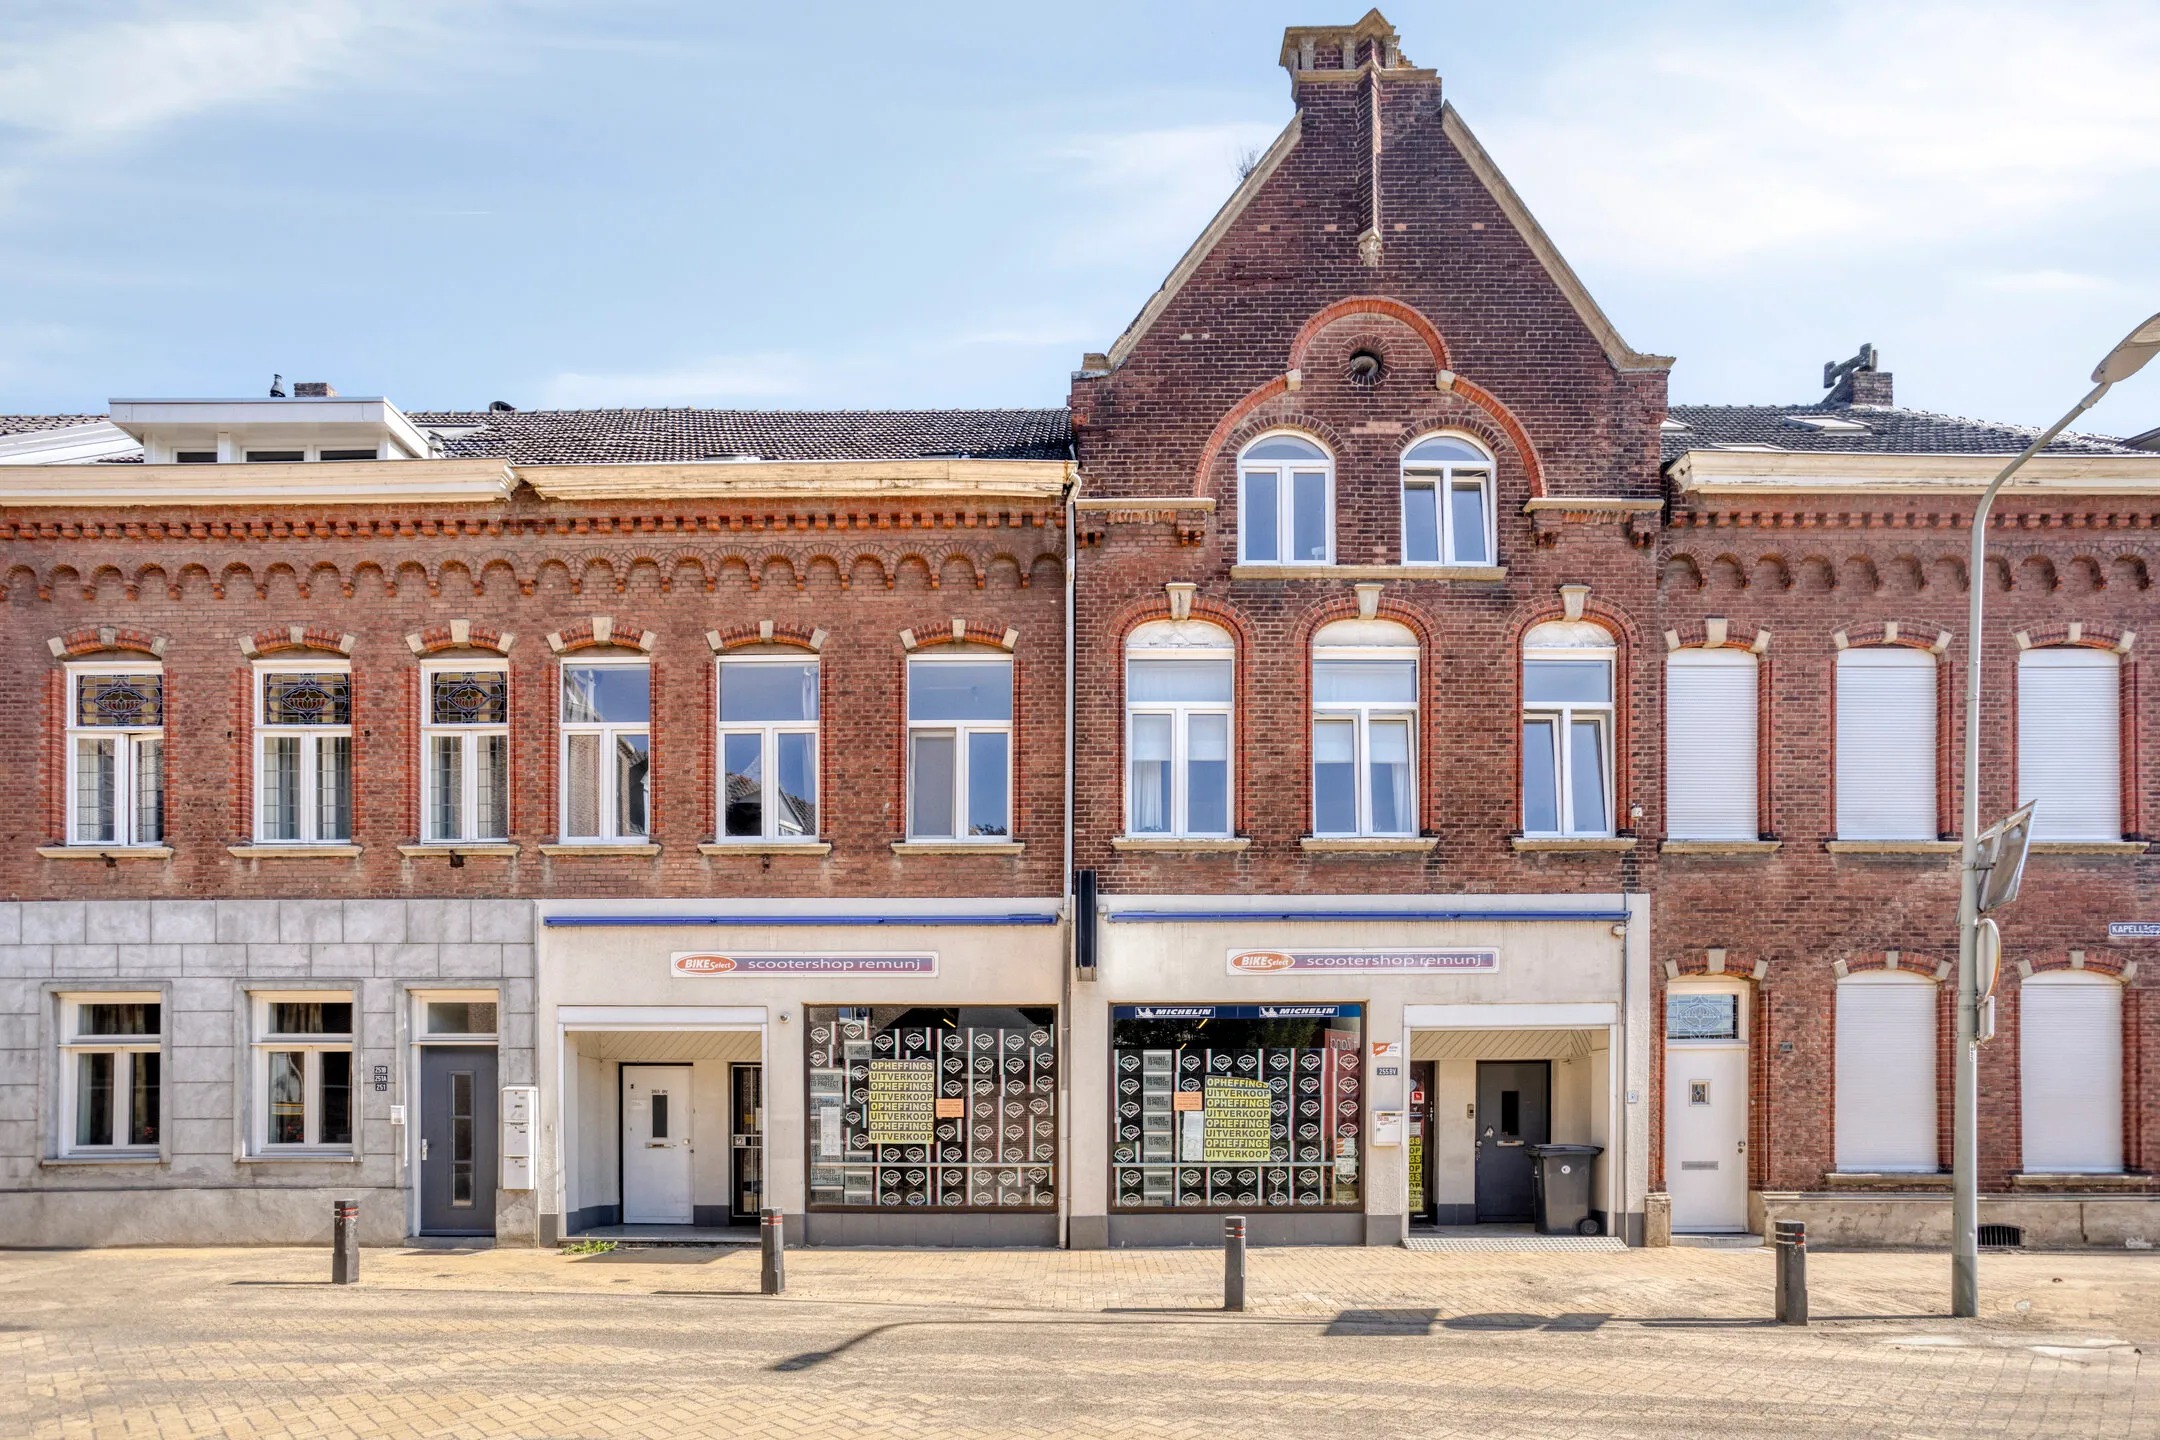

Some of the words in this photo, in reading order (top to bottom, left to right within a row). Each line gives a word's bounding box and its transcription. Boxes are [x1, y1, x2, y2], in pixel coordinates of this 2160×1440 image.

[2112, 925, 2160, 933] KAPELL
[748, 959, 854, 971] scootershop
[859, 959, 920, 971] remunj
[1306, 955, 1414, 968] scootershop
[1420, 954, 1481, 967] remunj
[870, 1062, 933, 1070] OPHEFFINGS
[870, 1082, 933, 1090] OPHEFFINGS
[1207, 1078, 1269, 1088] OPHEFFINGS
